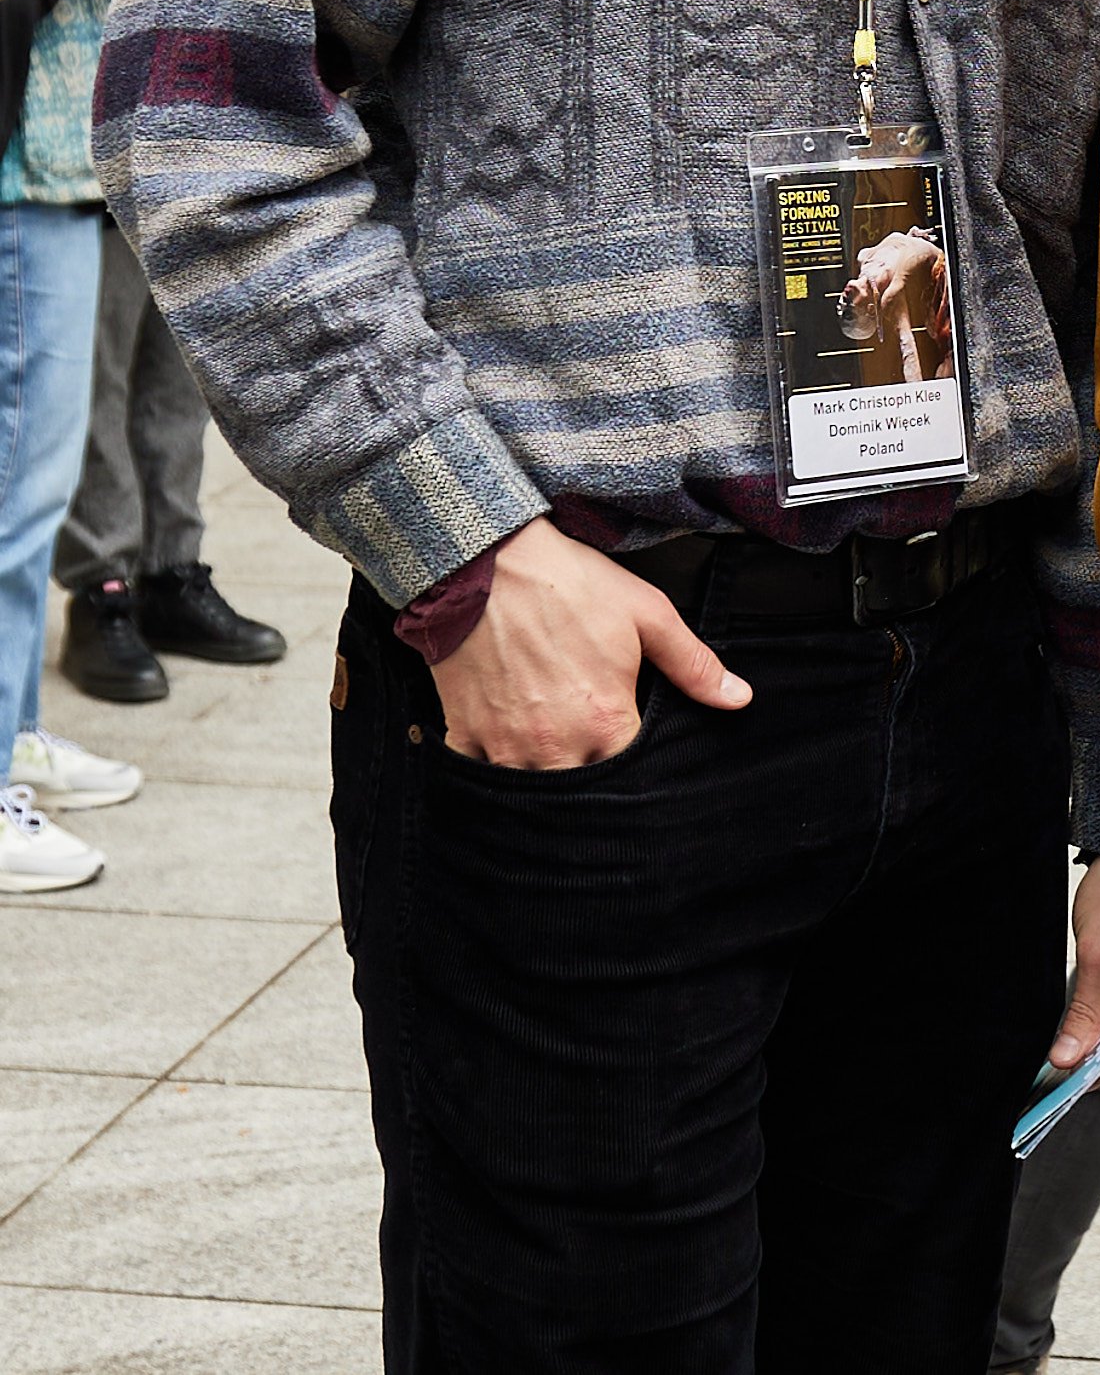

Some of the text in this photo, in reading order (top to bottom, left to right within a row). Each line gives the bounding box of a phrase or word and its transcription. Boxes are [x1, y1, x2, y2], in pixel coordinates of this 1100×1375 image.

[778, 189, 831, 206] SPRING
[780, 204, 840, 222] FORWARD
[781, 220, 840, 235] FESTIVAL
[813, 388, 941, 415] Mark Christoph Klee
[829, 413, 931, 438] Dominik Więcek
[859, 440, 904, 457] Poland
